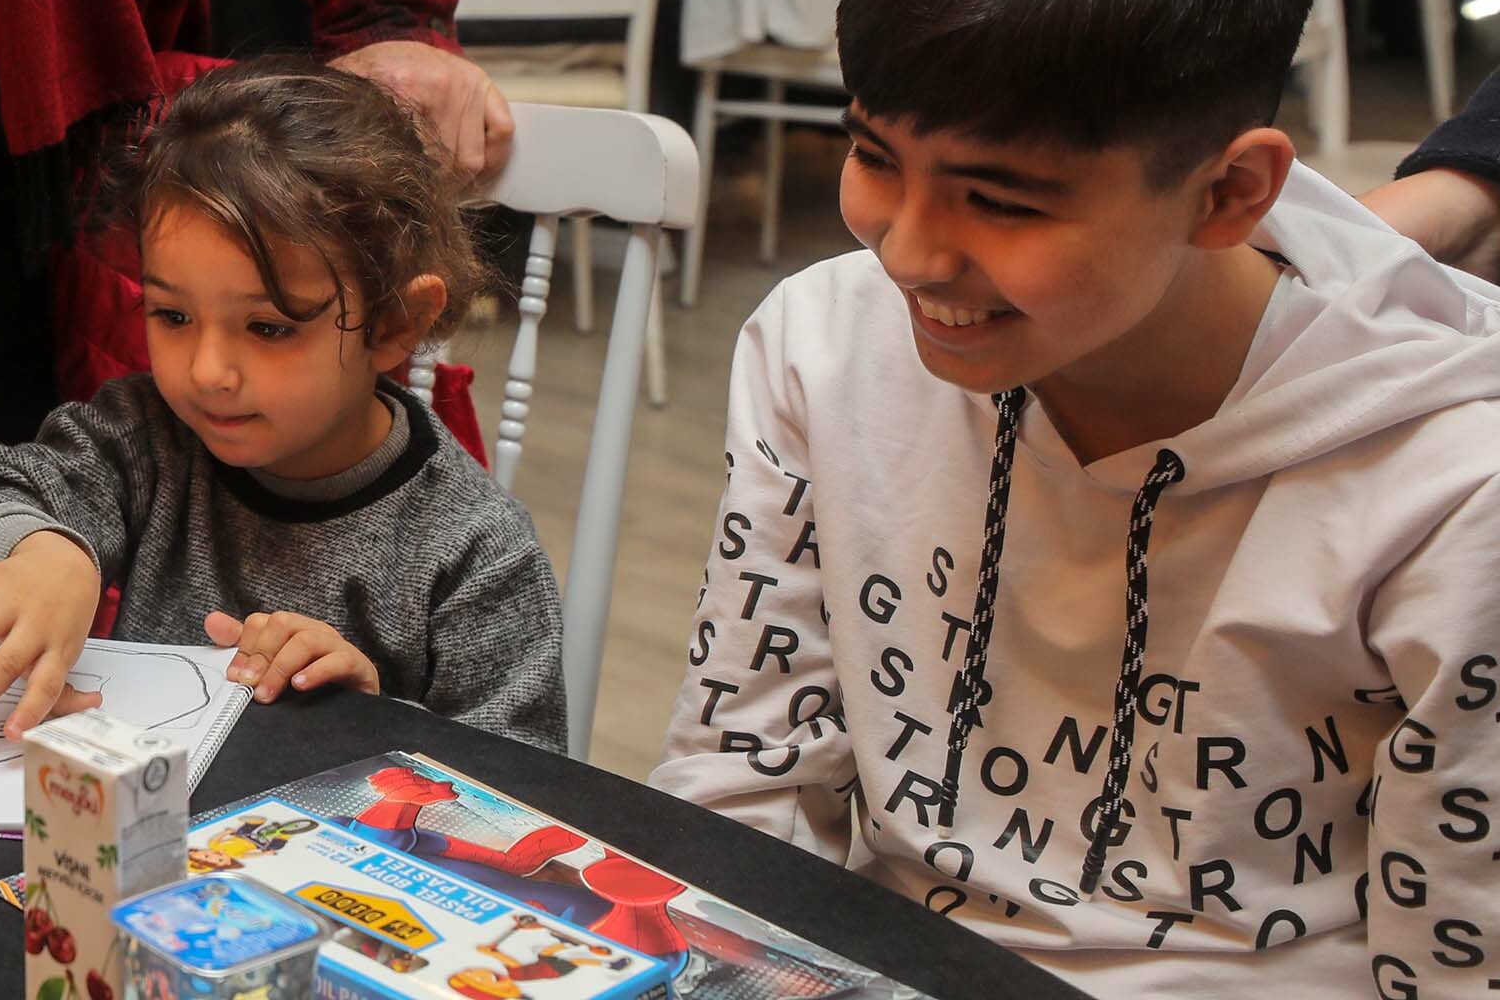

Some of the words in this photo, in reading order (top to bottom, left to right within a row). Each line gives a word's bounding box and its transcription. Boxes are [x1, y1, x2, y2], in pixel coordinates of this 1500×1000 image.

[360, 863, 413, 889] BOYA
[379, 856, 457, 892] PASTEL
[414, 887, 484, 922] PASTEL
[459, 892, 498, 911] OIL
